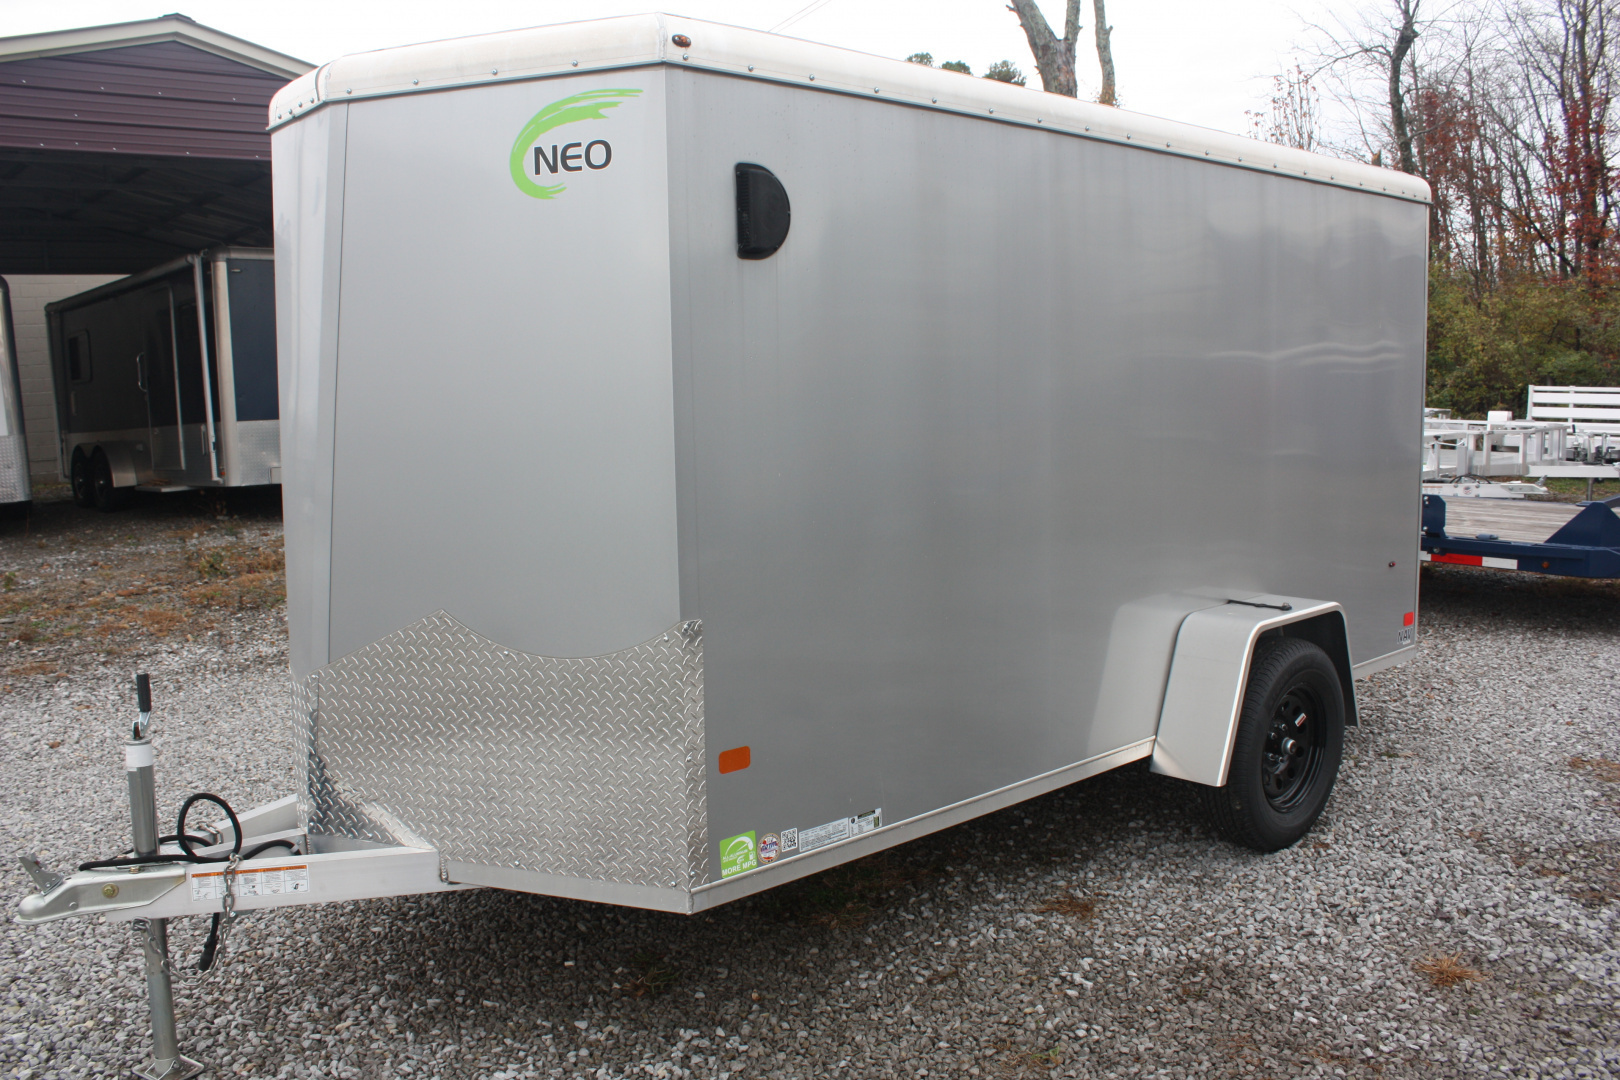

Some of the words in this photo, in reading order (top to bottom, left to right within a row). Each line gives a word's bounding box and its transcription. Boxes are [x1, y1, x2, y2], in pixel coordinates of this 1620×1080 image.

[533, 139, 612, 176] NEO
[722, 864, 741, 876] MORE
[742, 859, 757, 870] MPG
